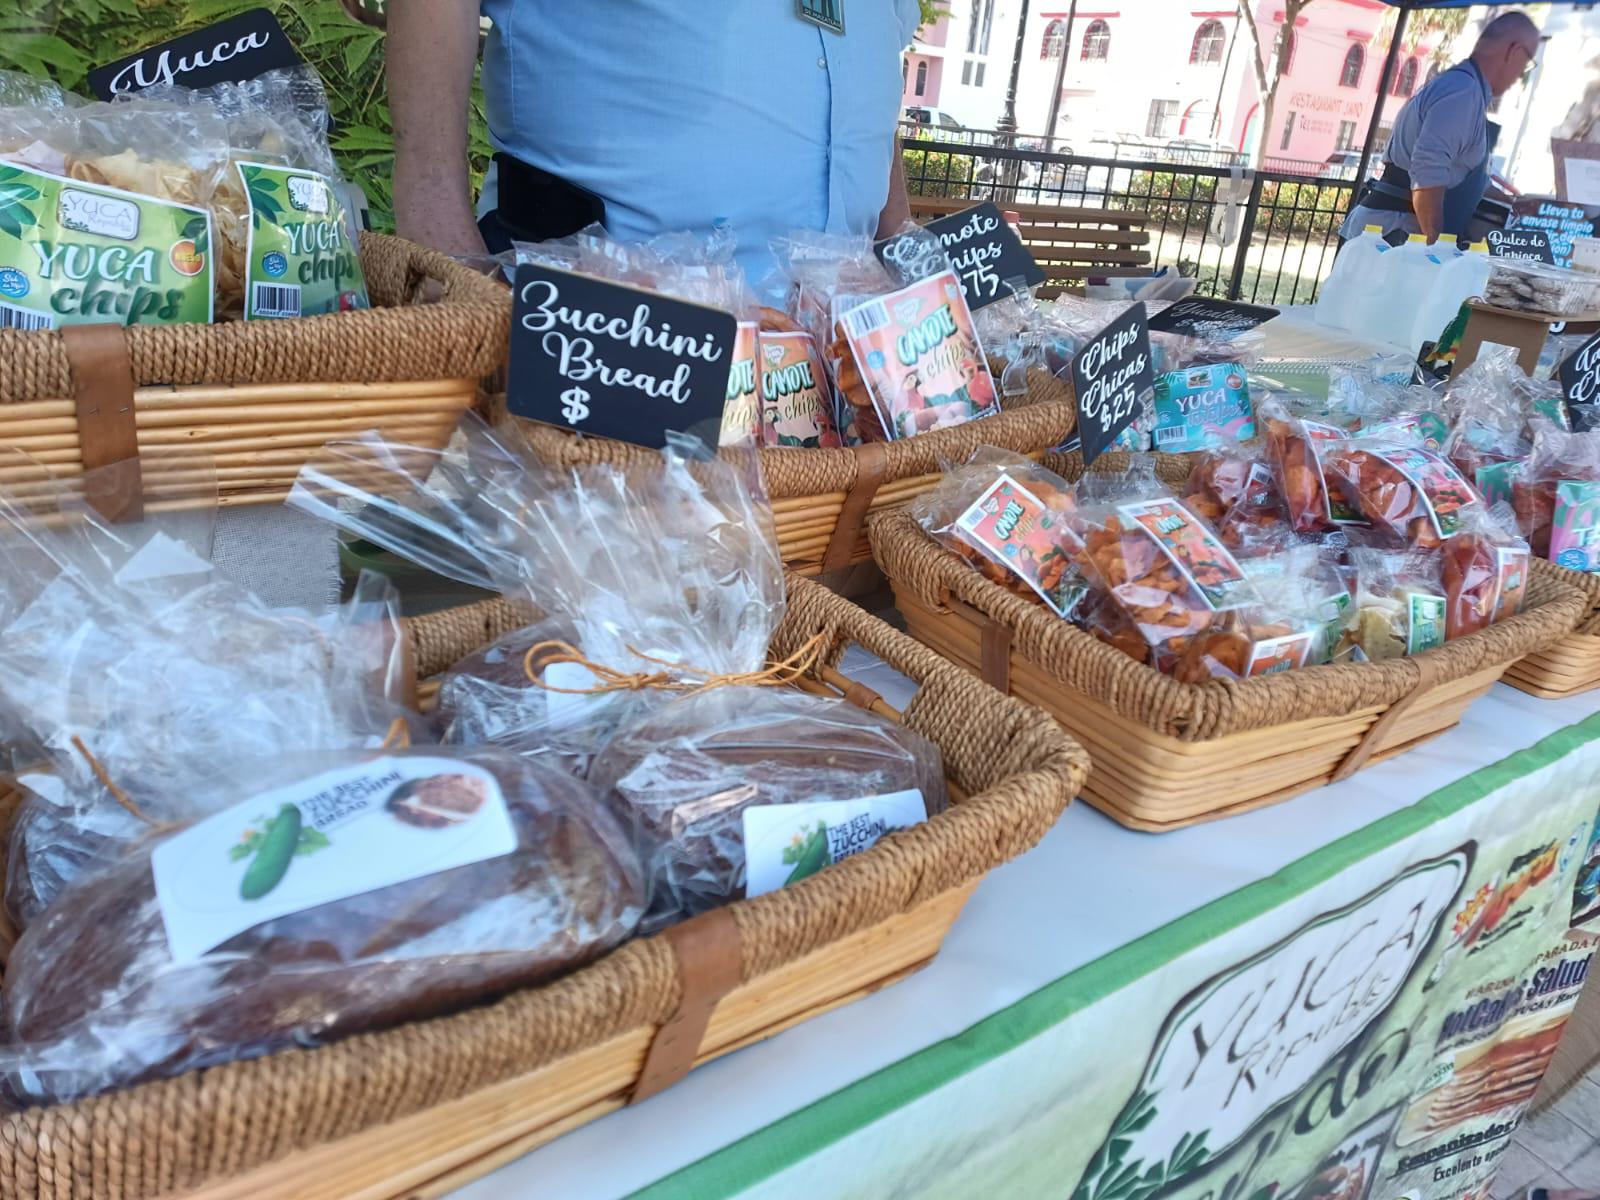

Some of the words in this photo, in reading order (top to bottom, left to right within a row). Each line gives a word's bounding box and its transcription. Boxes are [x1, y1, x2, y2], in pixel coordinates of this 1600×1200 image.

[109, 31, 270, 94] Yuca
[1538, 202, 1569, 219] Lleva
[284, 219, 341, 254] YUCA
[1487, 230, 1529, 247] Dulce
[1530, 232, 1546, 248] de
[32, 241, 156, 284] YUCA
[297, 251, 355, 292] chips
[50, 277, 185, 326] chips
[521, 280, 723, 362] Zucchini
[541, 331, 692, 404] Bread
[1080, 321, 1141, 382] Chips
[726, 358, 756, 399] OTE
[761, 360, 816, 402] CAMOTE
[1080, 352, 1148, 419] Chicas
[1175, 388, 1227, 412] YUCA
[559, 385, 591, 425] $
[1100, 382, 1136, 433] $25
[1182, 898, 1427, 1091] YUCA
[1527, 951, 1594, 1000] Salud
